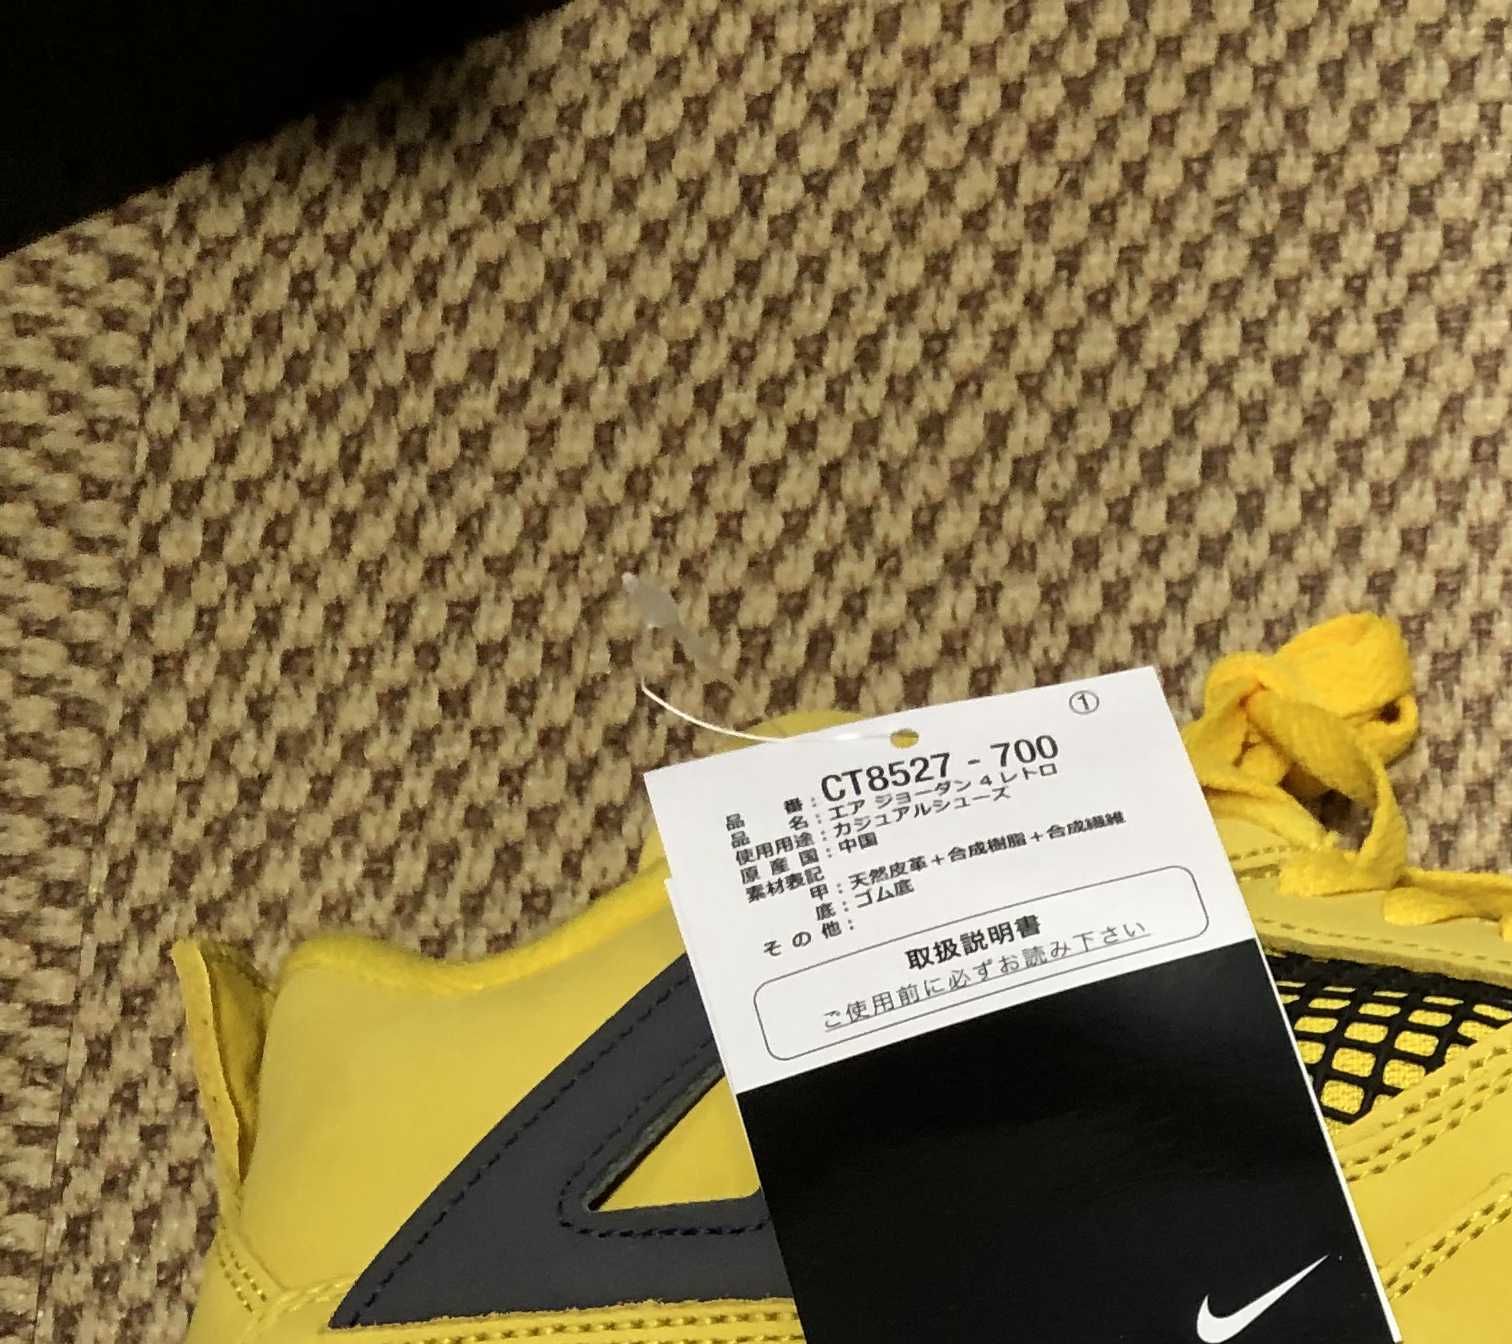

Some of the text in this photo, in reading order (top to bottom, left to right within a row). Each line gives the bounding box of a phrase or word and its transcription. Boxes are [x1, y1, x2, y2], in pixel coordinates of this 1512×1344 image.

[837, 831, 879, 855] 中国
[744, 864, 826, 904] 素材表記
[853, 877, 916, 909] ゴム底
[903, 913, 1041, 971] 取扱説明書
[824, 921, 1148, 1028] ご使用前に必ずお読み下さい
